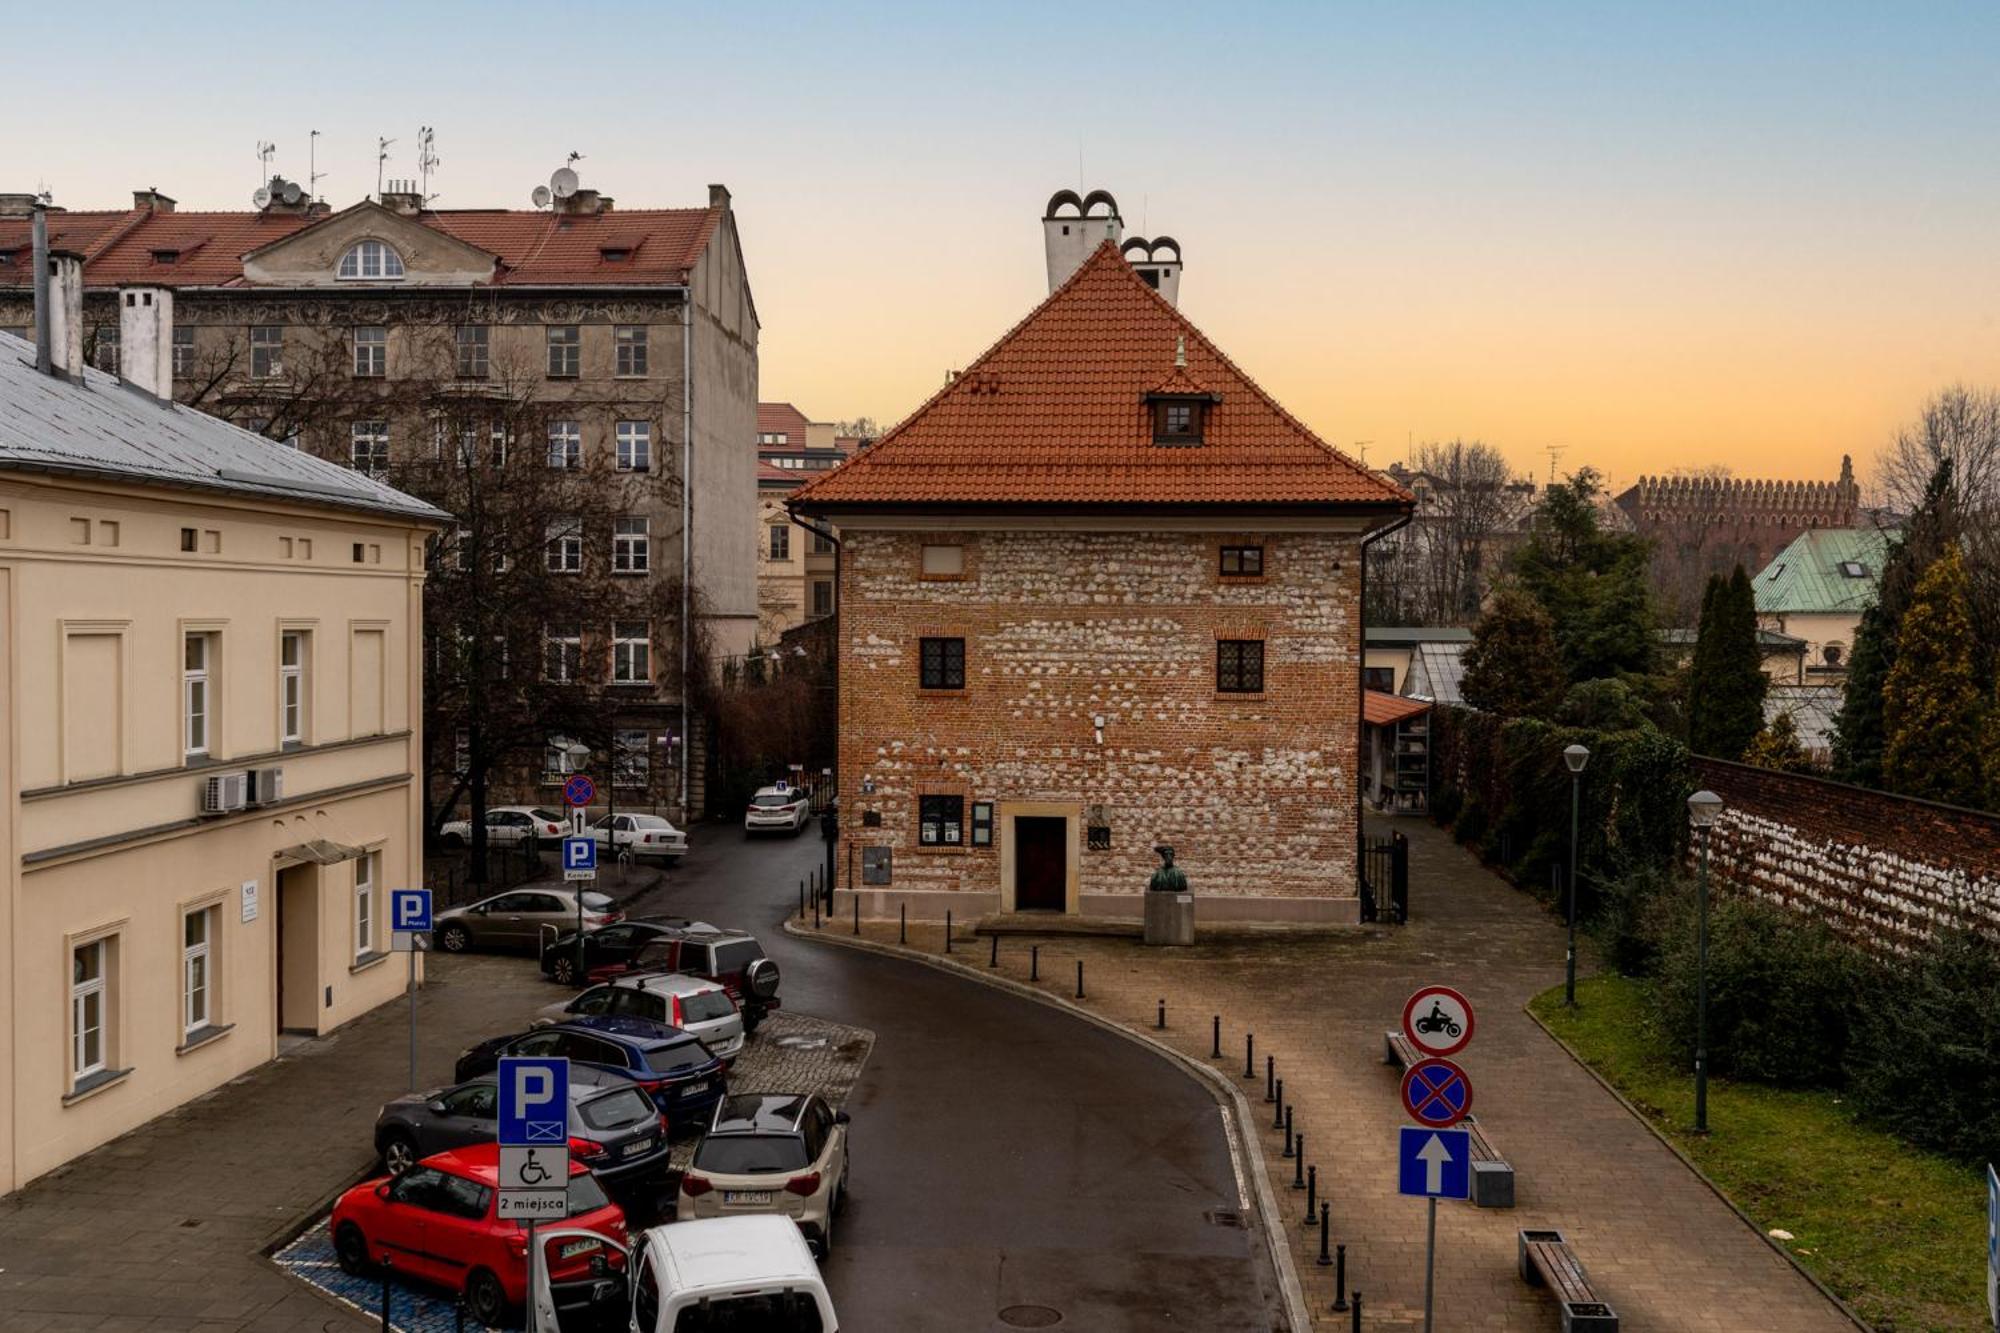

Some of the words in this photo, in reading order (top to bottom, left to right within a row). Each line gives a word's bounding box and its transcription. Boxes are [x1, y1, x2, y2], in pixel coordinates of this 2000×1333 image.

[570, 842, 588, 867] P
[400, 895, 423, 926] P
[514, 1066, 554, 1120] P
[500, 1198, 509, 1210] 2
[513, 1198, 564, 1212] miejsca
